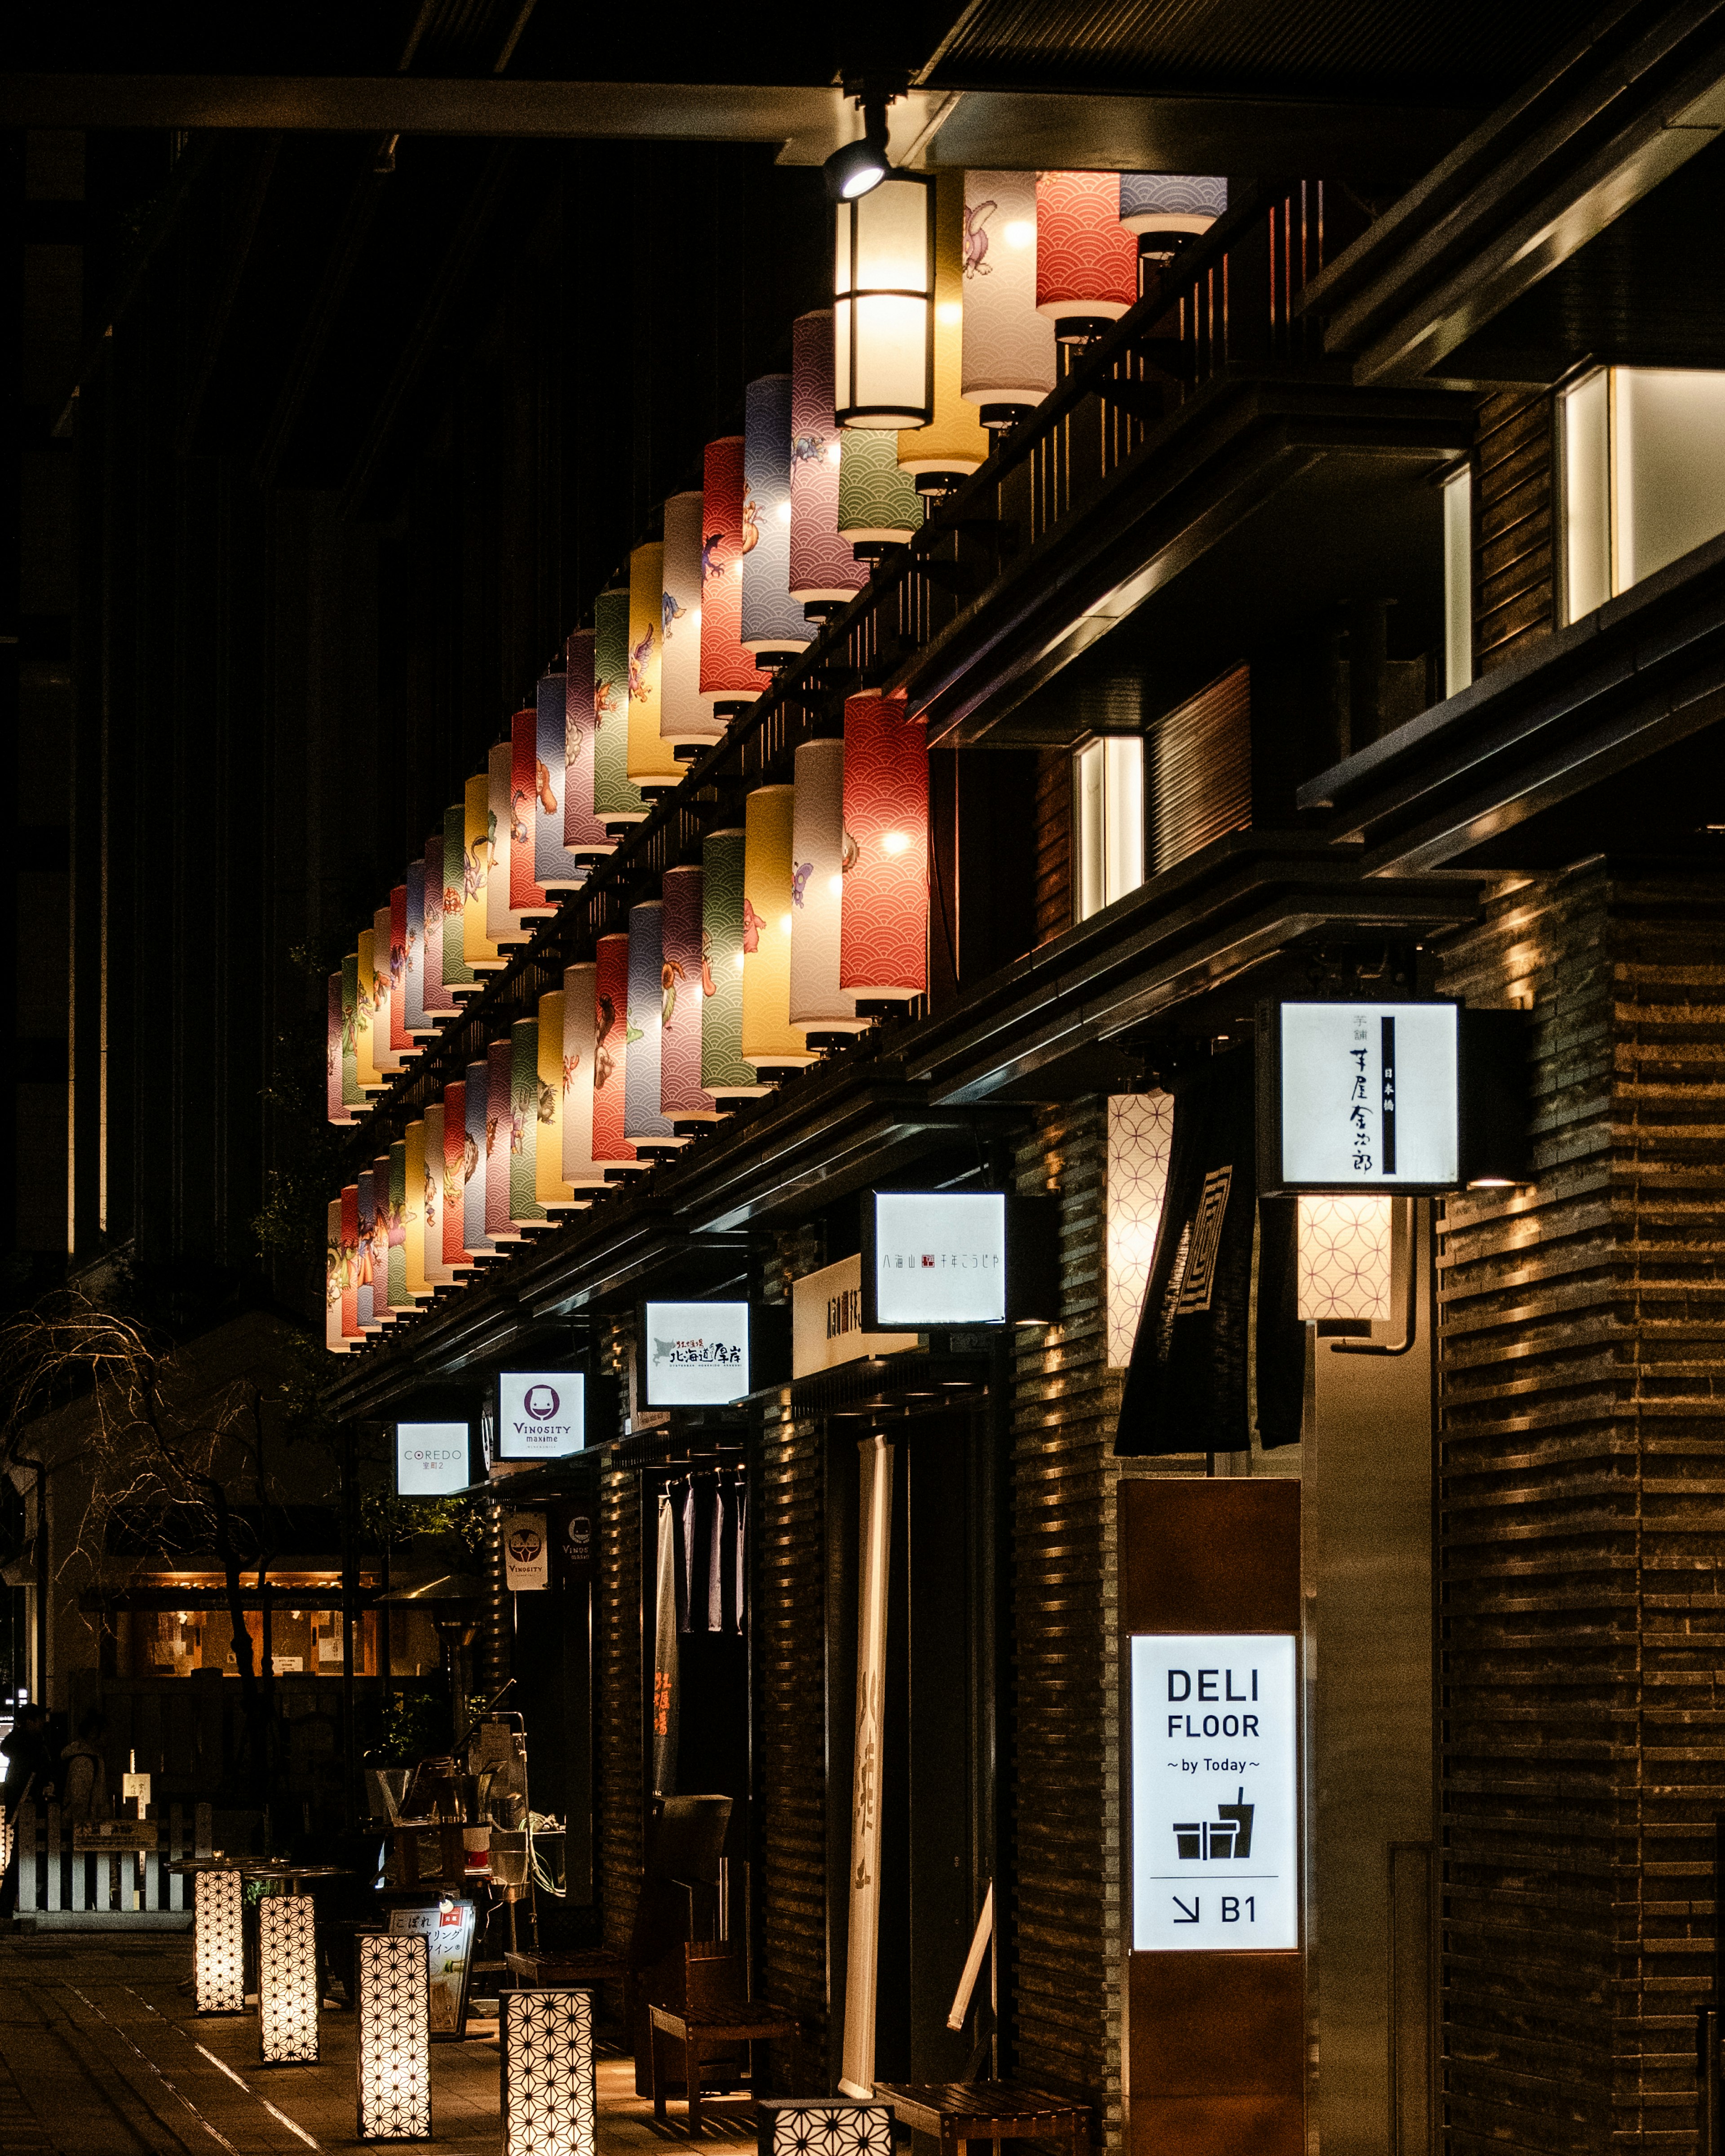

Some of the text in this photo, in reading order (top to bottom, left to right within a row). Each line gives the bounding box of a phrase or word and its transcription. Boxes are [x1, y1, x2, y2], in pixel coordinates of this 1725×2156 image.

[1384, 1068, 1394, 1112] 日本橋
[1349, 1048, 1373, 1174] 芋屋金次郎
[883, 1255, 999, 1268] 八海山 千年こうじや
[513, 1423, 571, 1434] VINOSITY
[404, 1450, 462, 1460] COREDO
[423, 1462, 443, 1470] 室町2
[1168, 1669, 1258, 1702] DELI
[1168, 1714, 1260, 1738] FLOOR
[1221, 1896, 1255, 1922] B1
[397, 1917, 431, 1928] こぼれ
